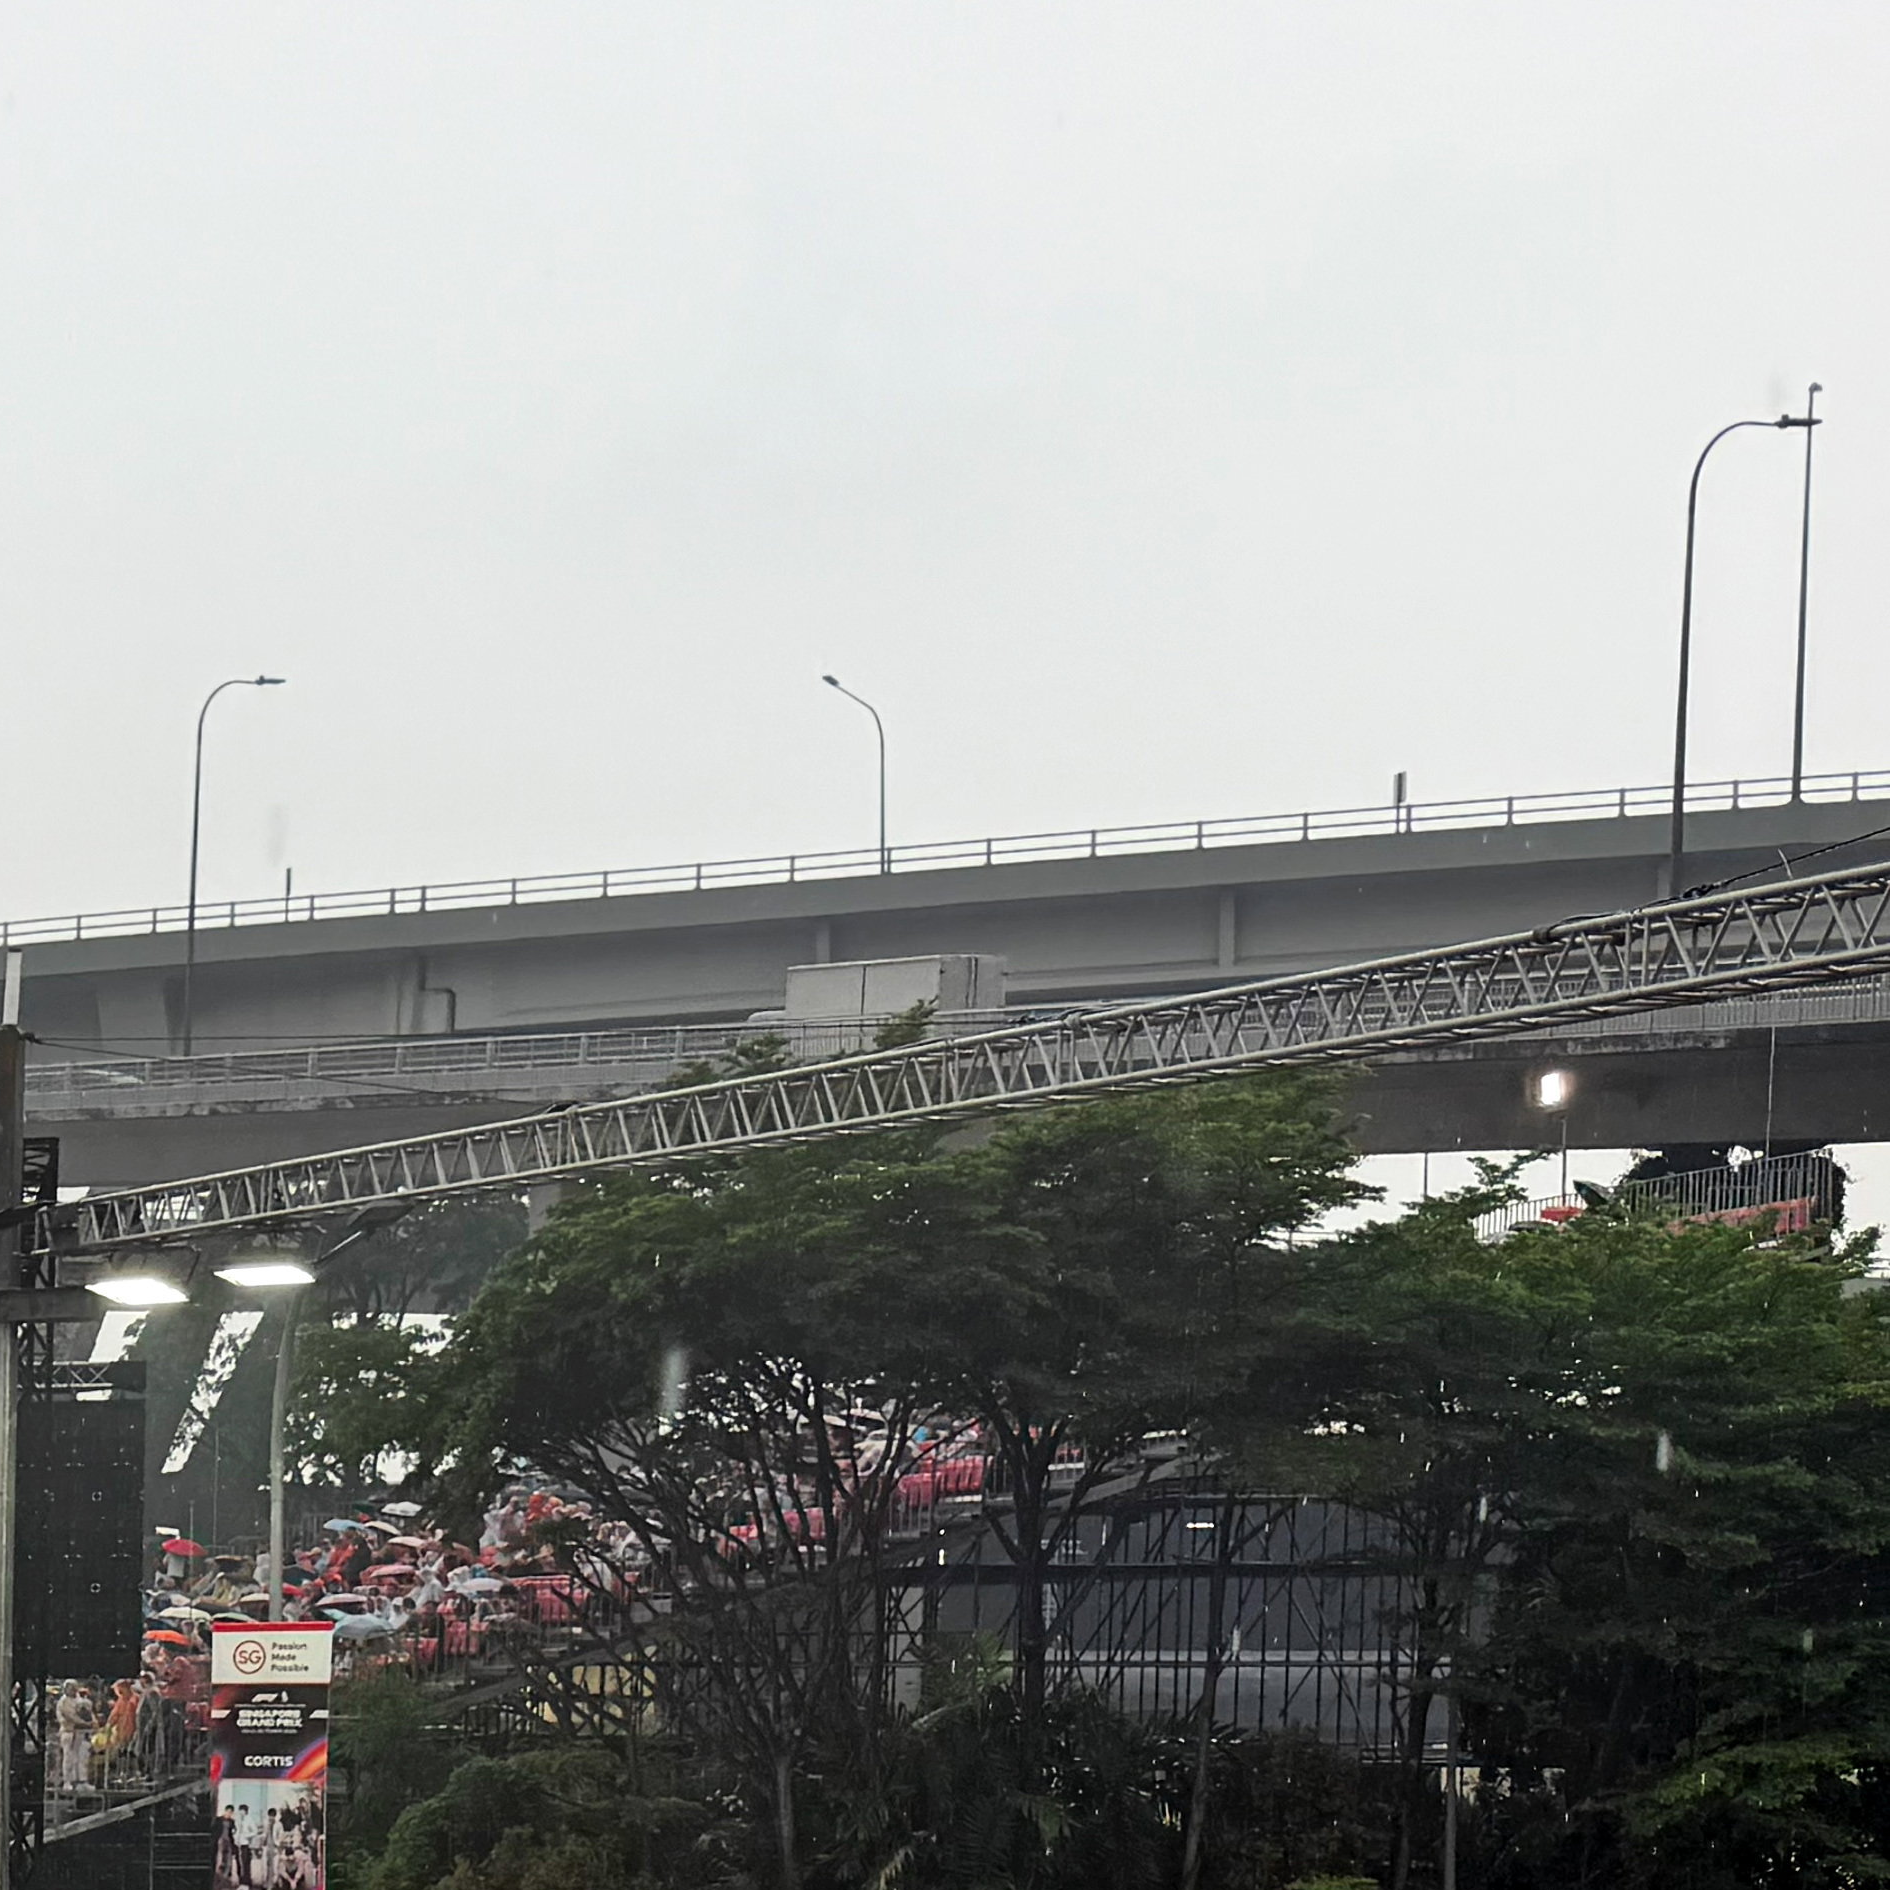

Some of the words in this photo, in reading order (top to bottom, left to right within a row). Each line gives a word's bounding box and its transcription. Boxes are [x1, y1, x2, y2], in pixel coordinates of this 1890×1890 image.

[238, 1650, 262, 1665] SG
[271, 1653, 297, 1662] Made
[244, 1755, 294, 1768] CORTIS
